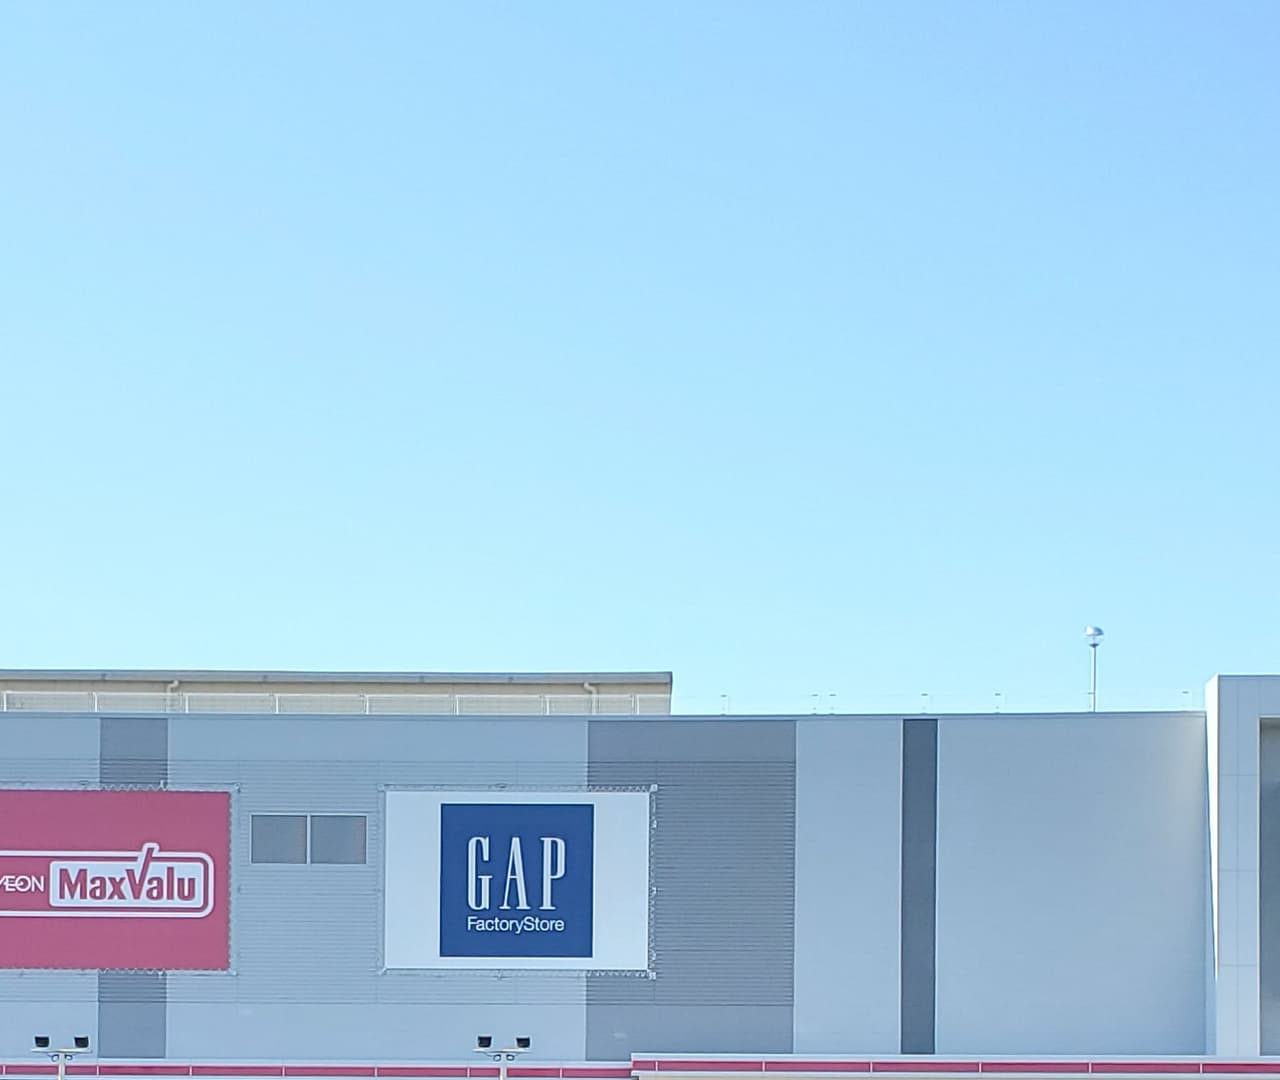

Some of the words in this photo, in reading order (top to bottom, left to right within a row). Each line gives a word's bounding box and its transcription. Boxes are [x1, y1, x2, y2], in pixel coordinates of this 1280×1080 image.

[58, 844, 196, 902] MaxValu
[467, 836, 567, 911] GAP
[467, 916, 565, 934] FactoryStore
